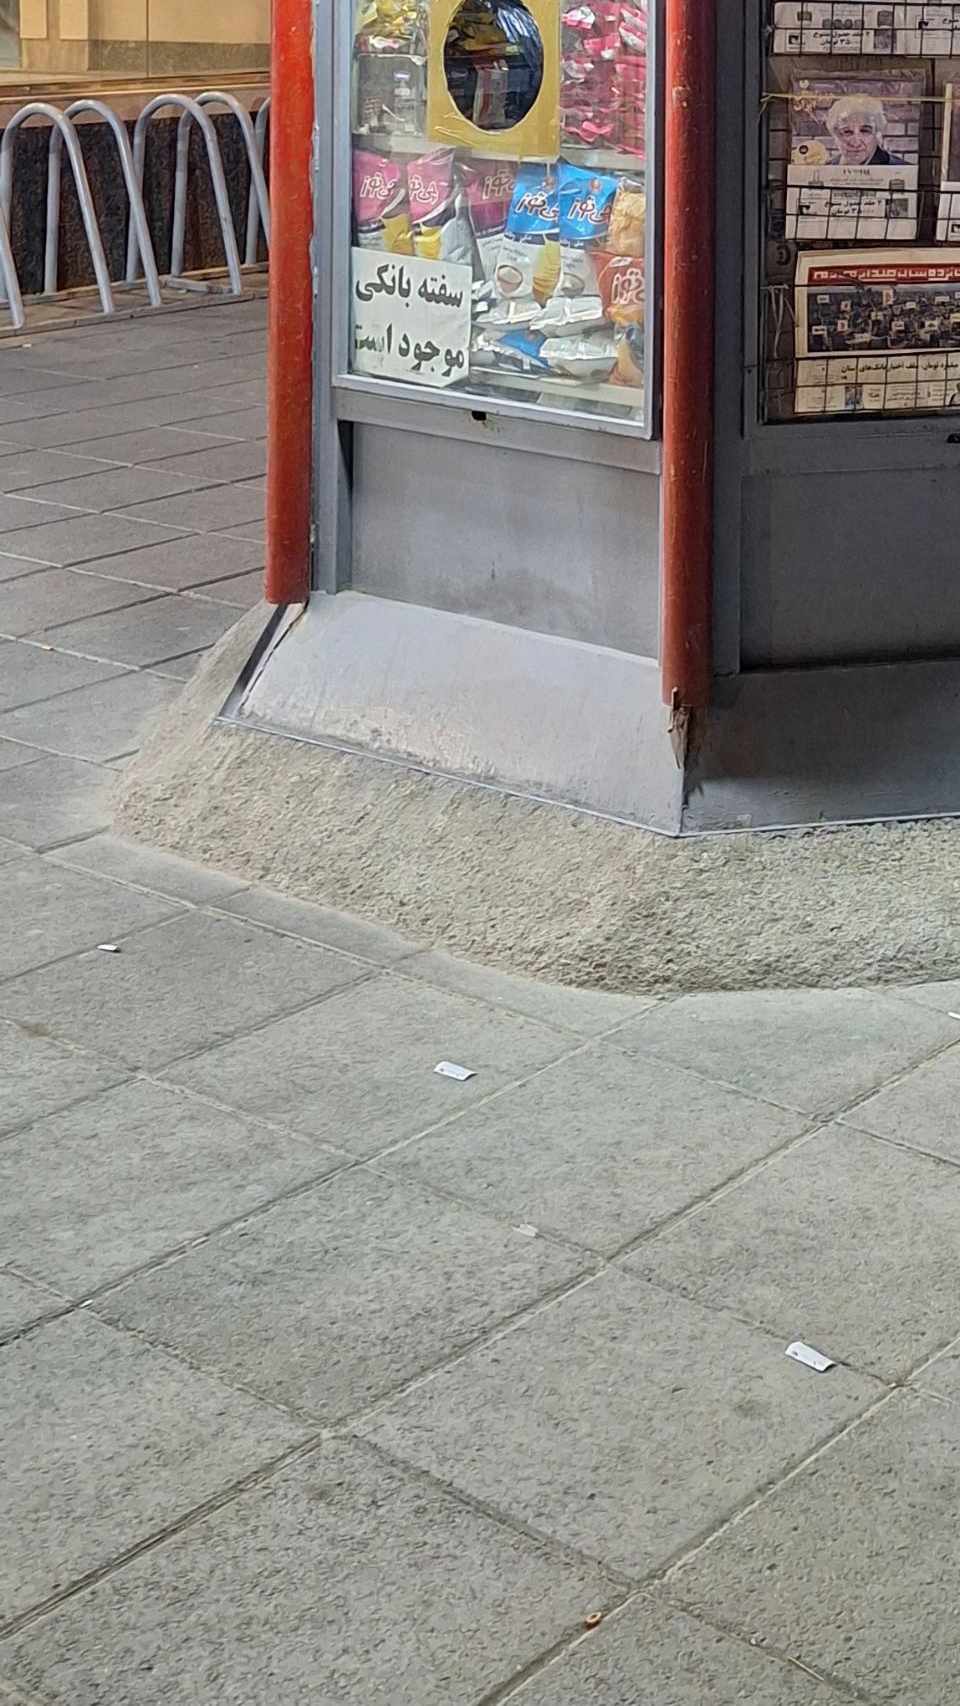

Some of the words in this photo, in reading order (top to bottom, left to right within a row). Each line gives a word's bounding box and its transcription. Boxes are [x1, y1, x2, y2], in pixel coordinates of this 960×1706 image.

[356, 263, 411, 308] بانکی
[418, 274, 463, 308] سفته
[399, 333, 464, 377] موجود
